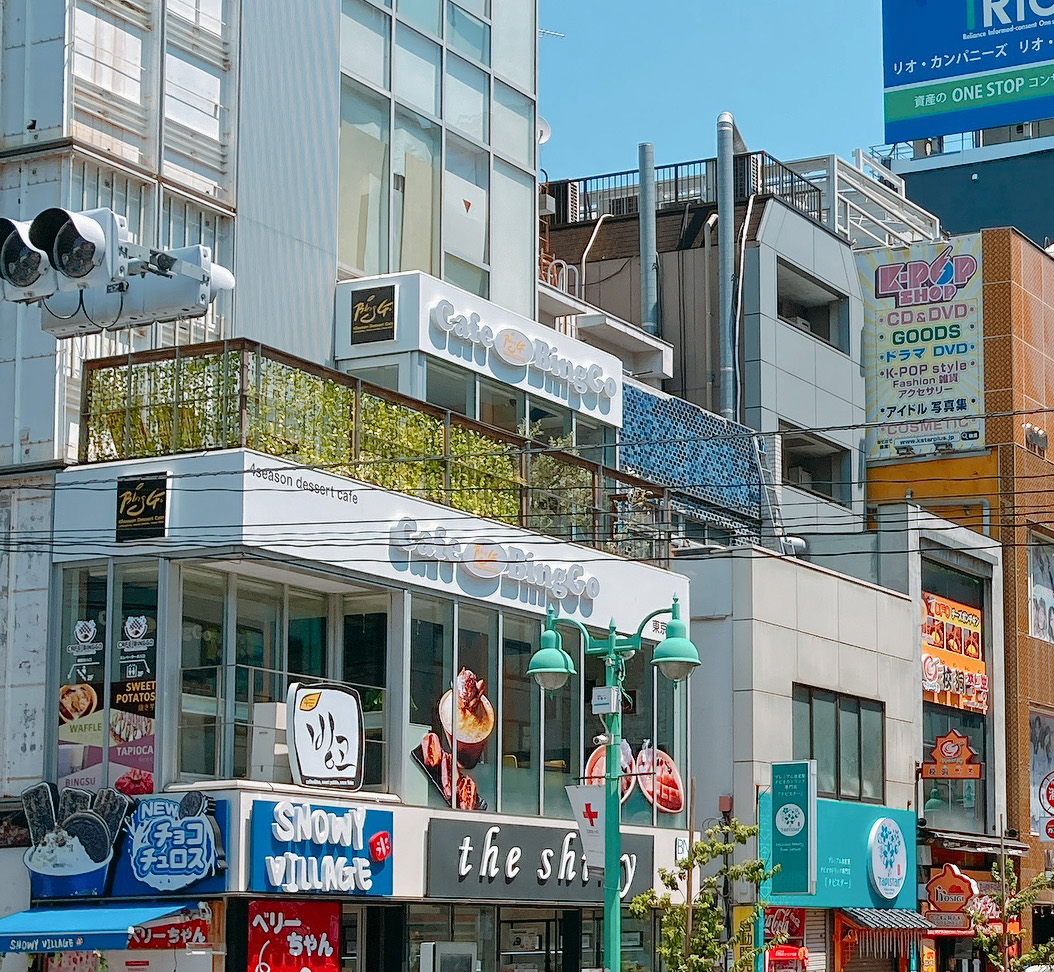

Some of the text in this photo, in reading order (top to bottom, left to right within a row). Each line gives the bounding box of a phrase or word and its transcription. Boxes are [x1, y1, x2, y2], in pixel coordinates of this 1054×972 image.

[894, 42, 1008, 75] リオ・カンパニーズ
[914, 91, 947, 108] 資産の
[952, 84, 984, 103] ONE
[986, 77, 1025, 98] STOP
[876, 246, 977, 296] K-POP
[899, 283, 957, 306] SHOP
[433, 299, 494, 348] Cafe
[892, 324, 961, 345] GOODS
[887, 343, 968, 363] ドラマ DVD
[886, 360, 968, 379] K-POP style
[893, 373, 959, 388] Fashion 雑貨
[898, 386, 953, 399] アクセサリー
[886, 398, 968, 418] アイドル 写真集
[887, 419, 969, 435] COSMETIC
[250, 463, 359, 505] 4season dessert cafe
[390, 517, 461, 561] Cafe
[126, 681, 156, 692] SWEET
[116, 692, 156, 704] POTATOS
[70, 723, 102, 733] WAFFLE
[117, 745, 154, 756] TAPIOCA
[66, 777, 96, 787] BINGSU
[141, 802, 181, 819] NEW
[152, 820, 206, 849] チョコ
[271, 801, 367, 850] SNOWY
[140, 847, 206, 873] チュロス
[457, 826, 637, 899] the shiy
[265, 851, 373, 893] VILLAGE
[252, 911, 302, 934] ベリー
[10, 938, 74, 950] SNOWY VILLAGE
[287, 932, 334, 957] ちゃん
